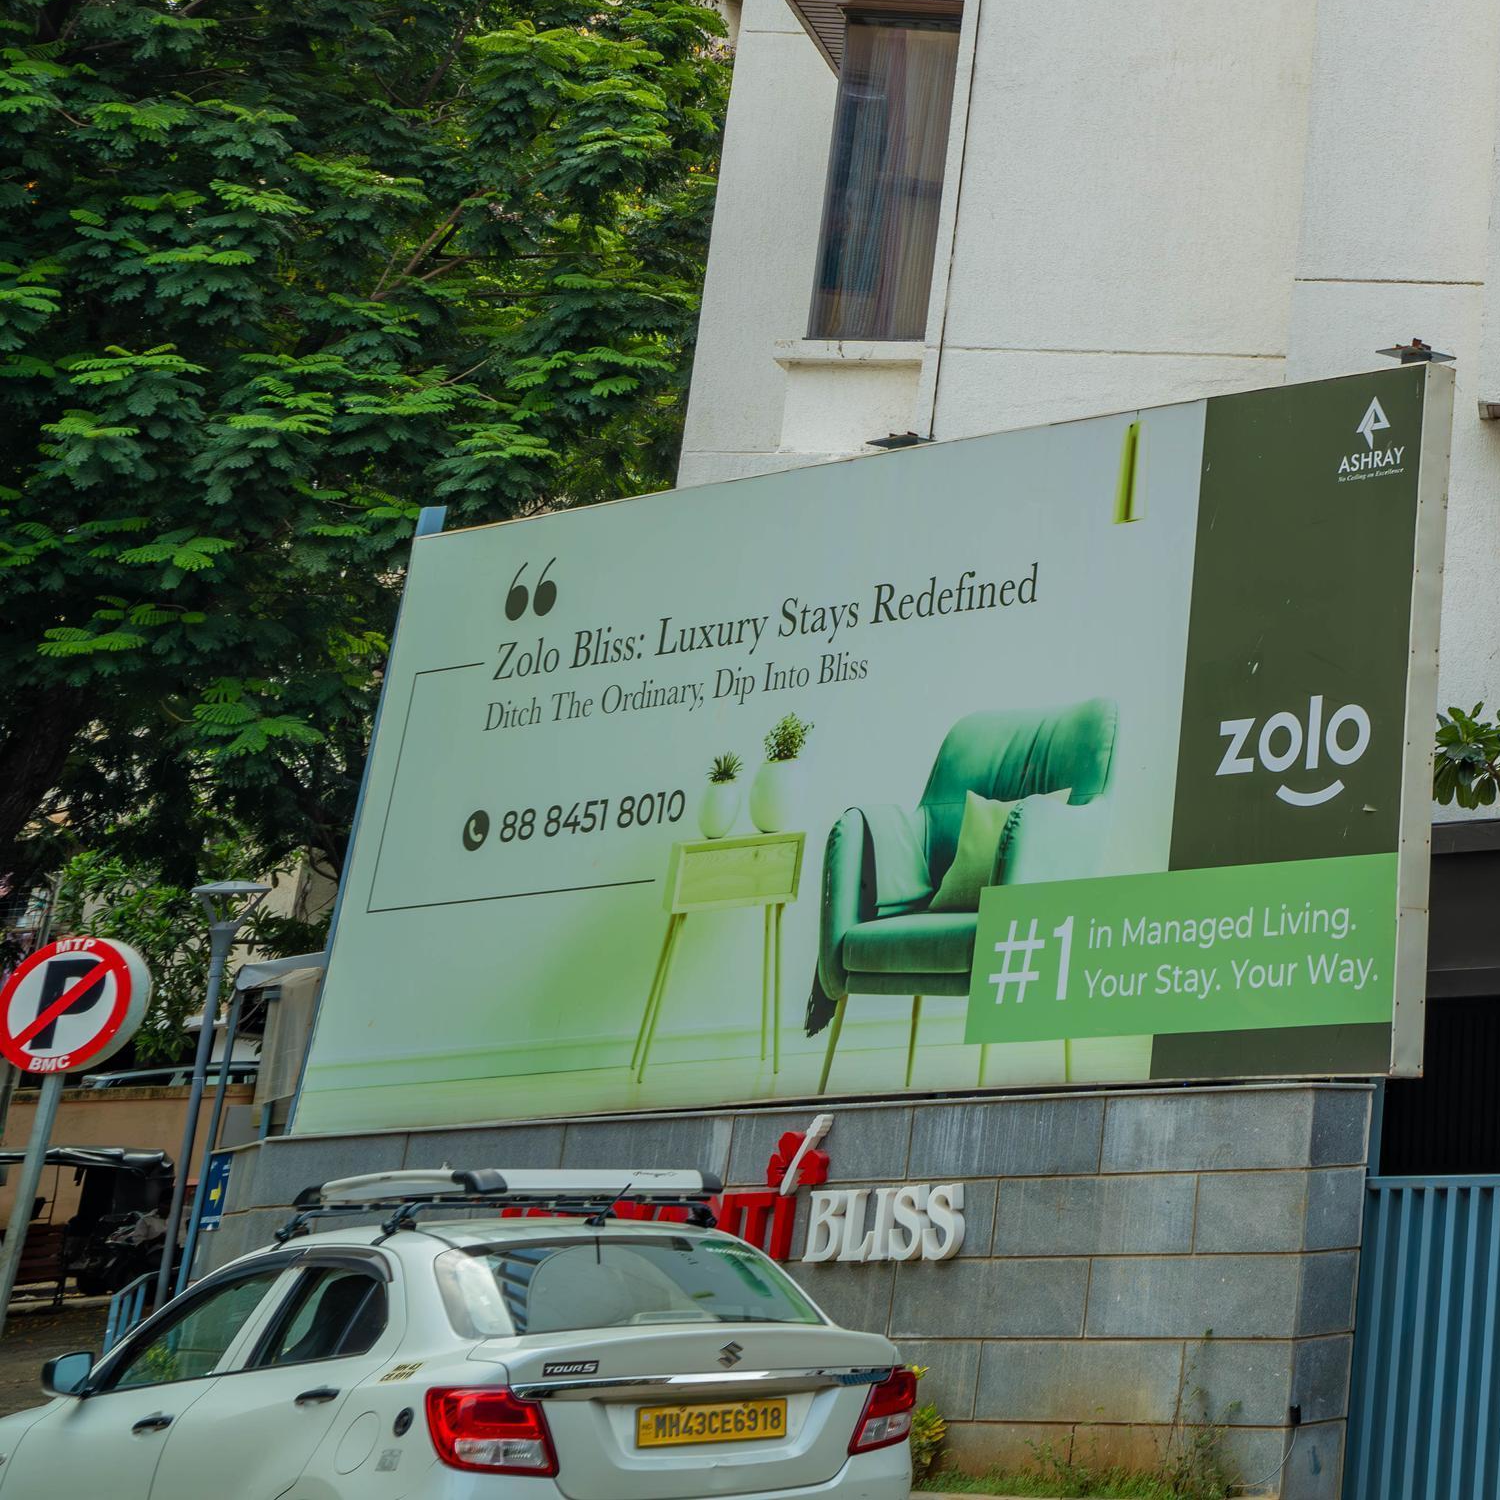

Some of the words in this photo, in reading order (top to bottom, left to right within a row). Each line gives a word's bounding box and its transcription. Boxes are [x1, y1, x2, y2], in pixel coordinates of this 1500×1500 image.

[1338, 446, 1405, 473] ASHRAY
[492, 637, 560, 681] Zolo
[568, 626, 645, 669] Bliss:
[654, 615, 769, 655] Luxury
[778, 596, 859, 644] Stays
[869, 562, 1039, 625] Redefined
[483, 702, 541, 731] Ditch
[551, 690, 594, 722] The
[601, 679, 704, 712] Ordinary,
[712, 667, 755, 705] Dip
[762, 661, 810, 692] Into
[817, 651, 868, 684] Bliss
[1215, 694, 1371, 776] zolo
[500, 808, 536, 843] 88
[544, 799, 609, 838] 8451
[617, 789, 686, 829] 8010
[55, 938, 97, 954] MTP
[1088, 918, 1113, 949] in
[1121, 907, 1255, 949] Managed
[1263, 901, 1358, 940] Living.
[988, 915, 1074, 1005] #1
[1084, 968, 1148, 999] Your
[1154, 964, 1222, 1000] Stay.
[1230, 959, 1298, 990] Your
[1306, 952, 1379, 991] Way.
[28, 1055, 71, 1071] BMC
[802, 1183, 966, 1262] BLISS
[654, 1406, 782, 1439] MH43CE6918
